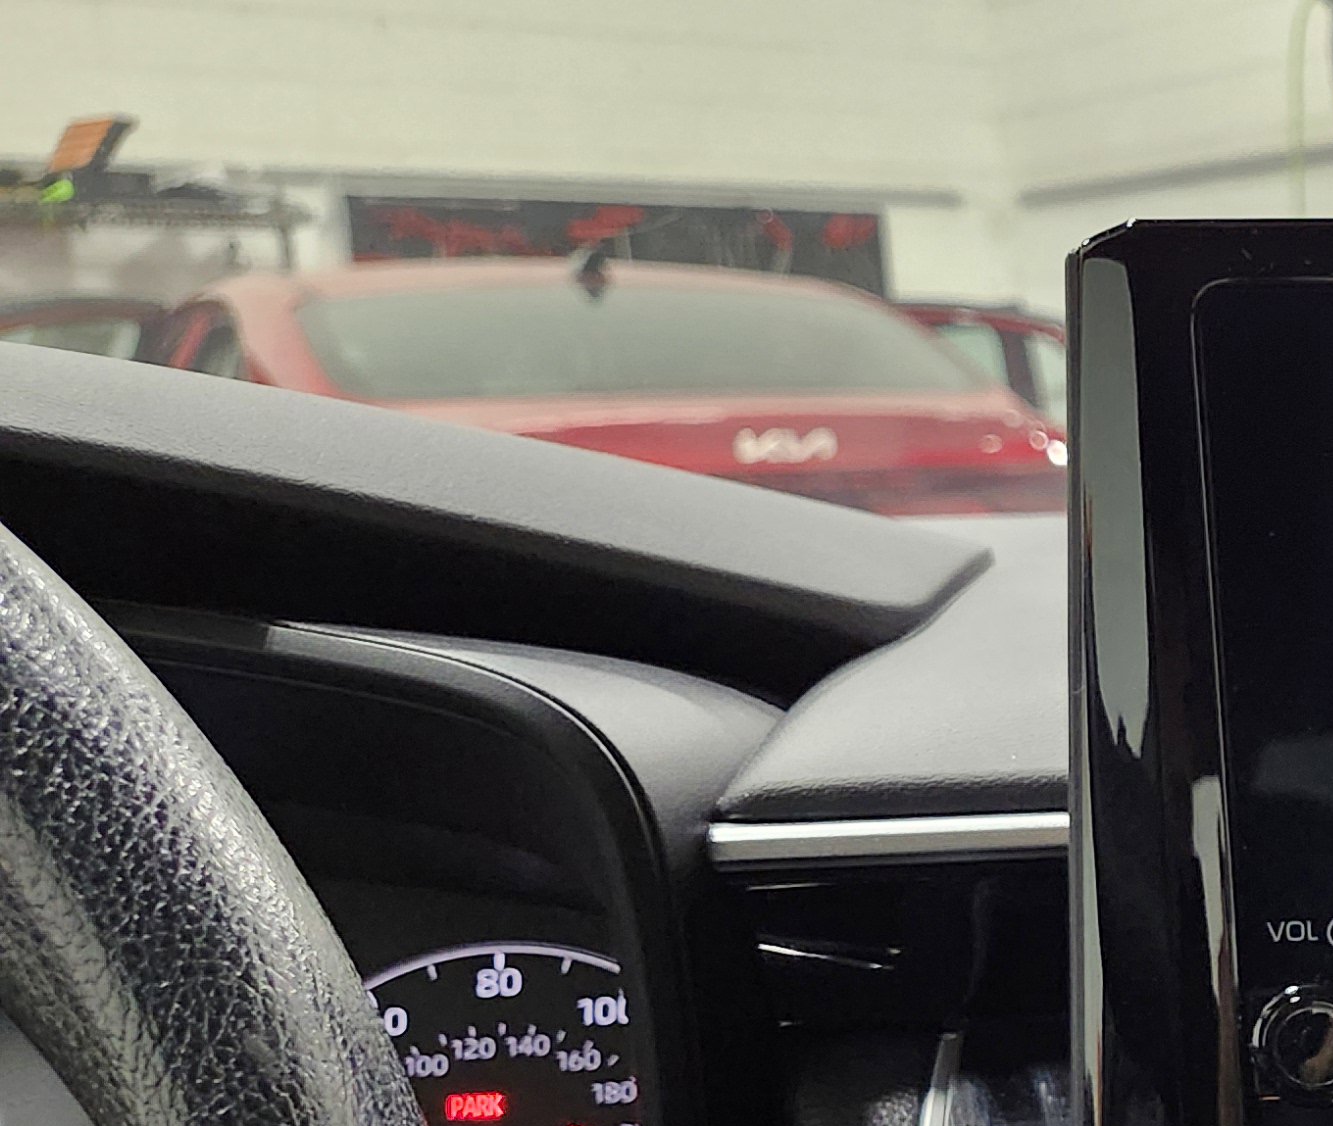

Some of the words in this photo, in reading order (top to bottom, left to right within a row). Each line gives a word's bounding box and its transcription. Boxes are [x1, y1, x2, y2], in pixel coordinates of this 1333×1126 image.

[1266, 919, 1319, 943] VOL
[475, 967, 523, 999] 80
[450, 1036, 497, 1060] 120
[505, 1033, 550, 1058] 140
[404, 1054, 449, 1078] 100
[556, 1048, 602, 1072] 160
[448, 1093, 505, 1119] PARK
